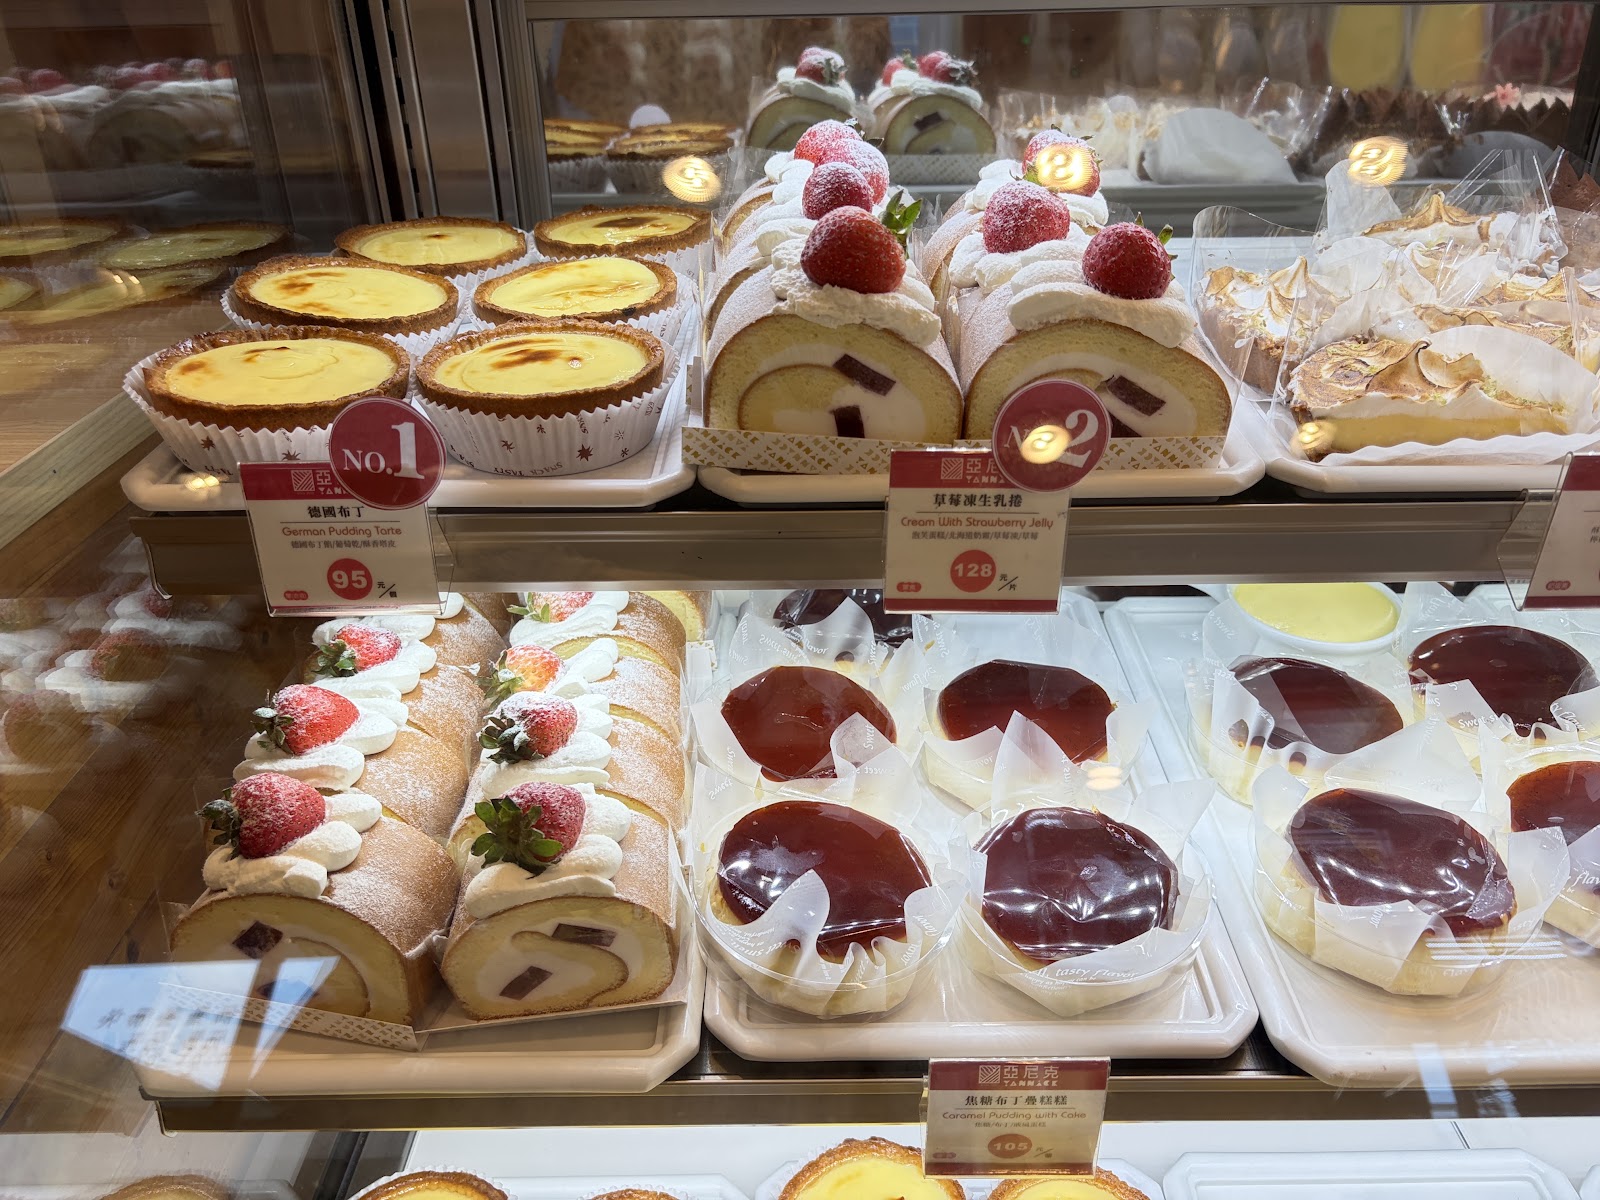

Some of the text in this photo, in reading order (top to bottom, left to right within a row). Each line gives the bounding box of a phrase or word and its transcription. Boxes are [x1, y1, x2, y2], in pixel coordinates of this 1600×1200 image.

[933, 493, 1023, 508] 草莓凍生乳捲
[307, 505, 364, 518] 德國布丁
[901, 517, 1054, 530] Cream With Strawberry Jelly
[281, 525, 402, 538] German Pudding Tarte
[954, 563, 993, 578] 128
[332, 570, 368, 589] 95
[1055, 967, 1090, 977] tasty
[1003, 1065, 1059, 1079] 亞尼克
[942, 1112, 986, 1120] Caramel
[988, 1112, 1032, 1121] Pudding
[1060, 1111, 1087, 1119] Cake
[993, 1142, 1028, 1151] 105
